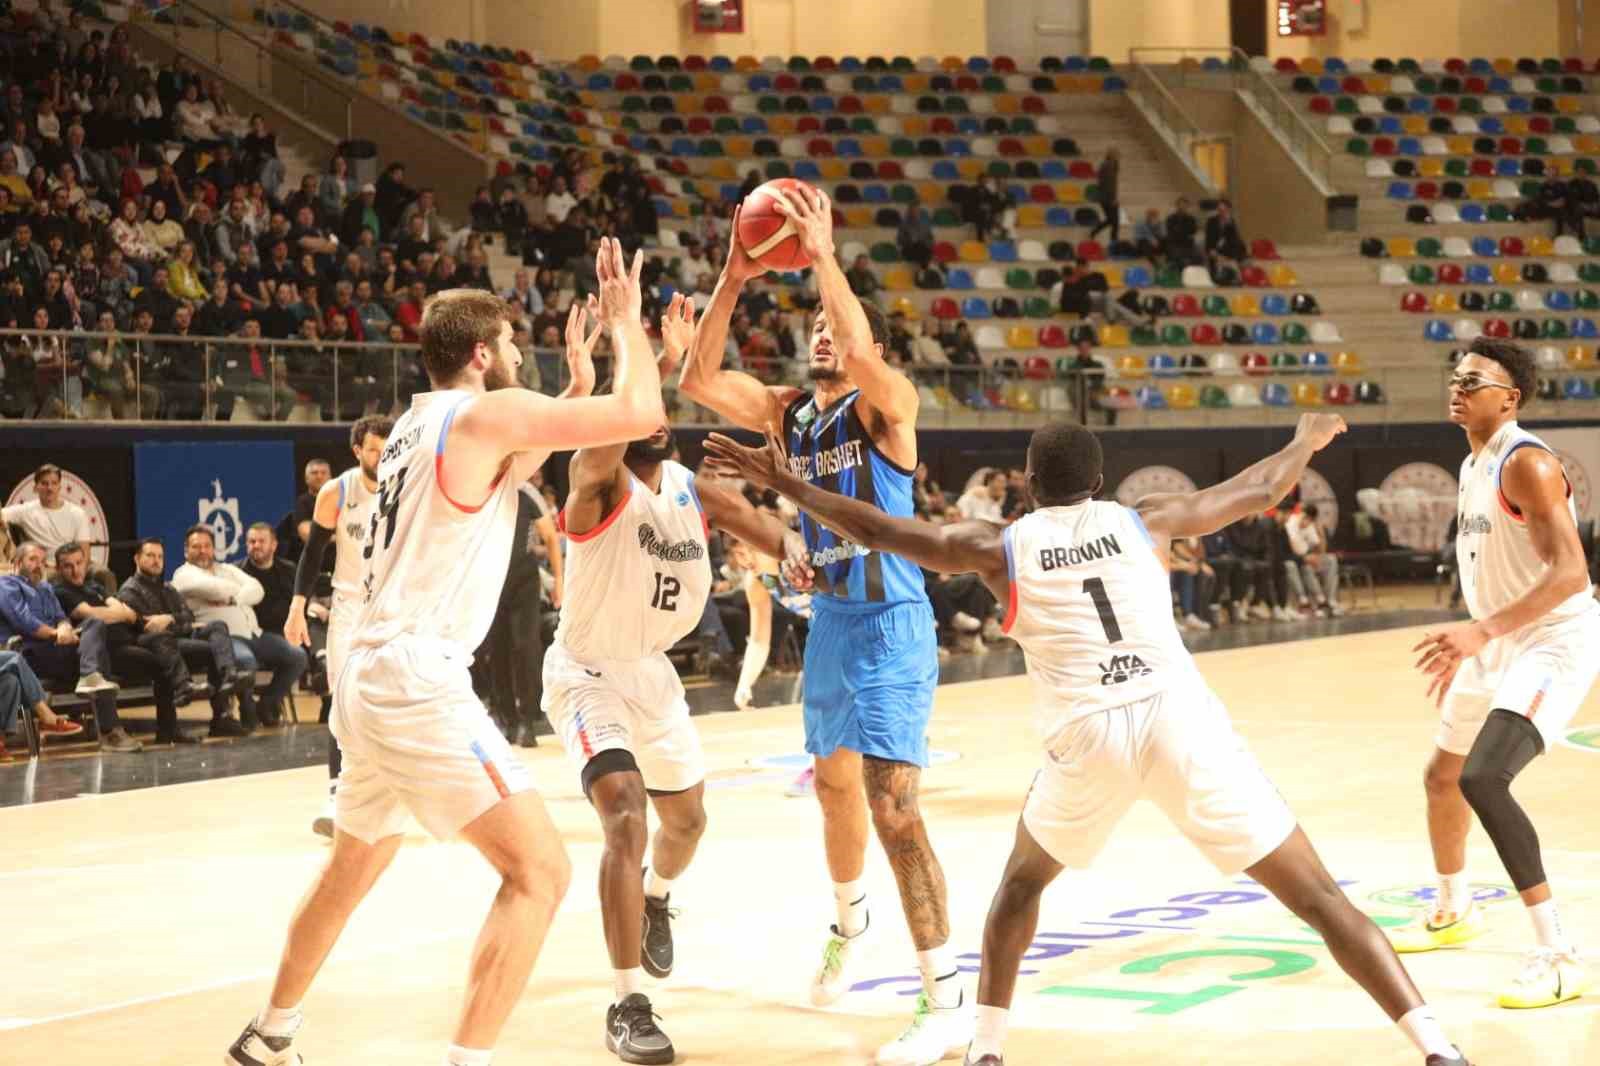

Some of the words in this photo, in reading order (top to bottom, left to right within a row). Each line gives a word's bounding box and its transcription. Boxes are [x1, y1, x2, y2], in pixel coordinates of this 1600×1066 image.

[815, 439, 863, 477] BASKET
[1040, 533, 1122, 571] BROWN
[651, 571, 681, 611] 12
[1082, 577, 1123, 644] 1
[1098, 654, 1146, 672] VITA
